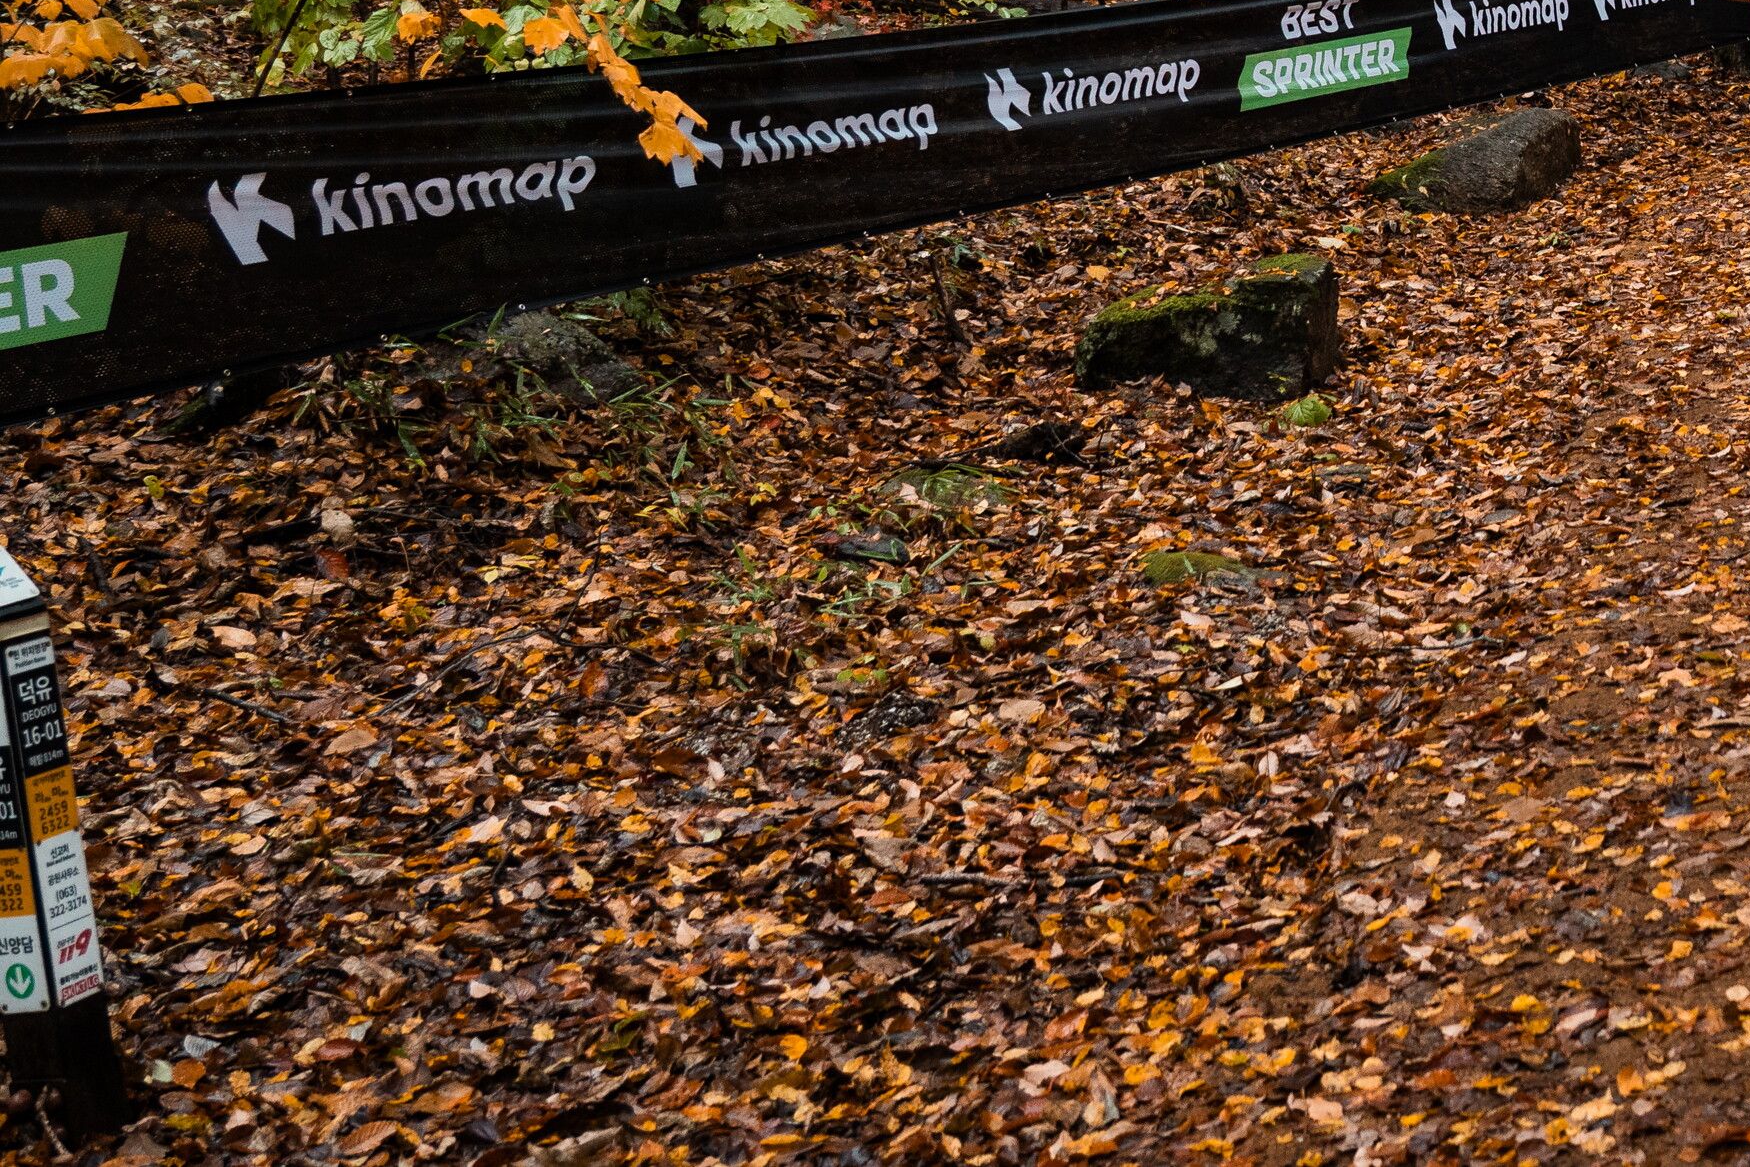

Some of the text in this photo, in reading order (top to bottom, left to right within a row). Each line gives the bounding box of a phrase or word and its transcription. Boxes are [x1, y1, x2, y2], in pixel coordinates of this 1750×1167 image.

[1252, 39, 1400, 98] SPRINTER
[1042, 58, 1201, 116] kinomap
[731, 103, 938, 167] kinomap
[313, 155, 596, 236] kinomap
[19, 675, 53, 706] 덕유
[22, 704, 58, 723] DEOGYU
[23, 719, 64, 749] 16-01
[39, 800, 69, 821] 2459
[41, 814, 70, 835] 6322
[0, 883, 22, 896] 459
[56, 884, 78, 902] (063)
[0, 898, 24, 912] 322
[49, 895, 88, 919] 322-3174
[59, 928, 92, 965] 119
